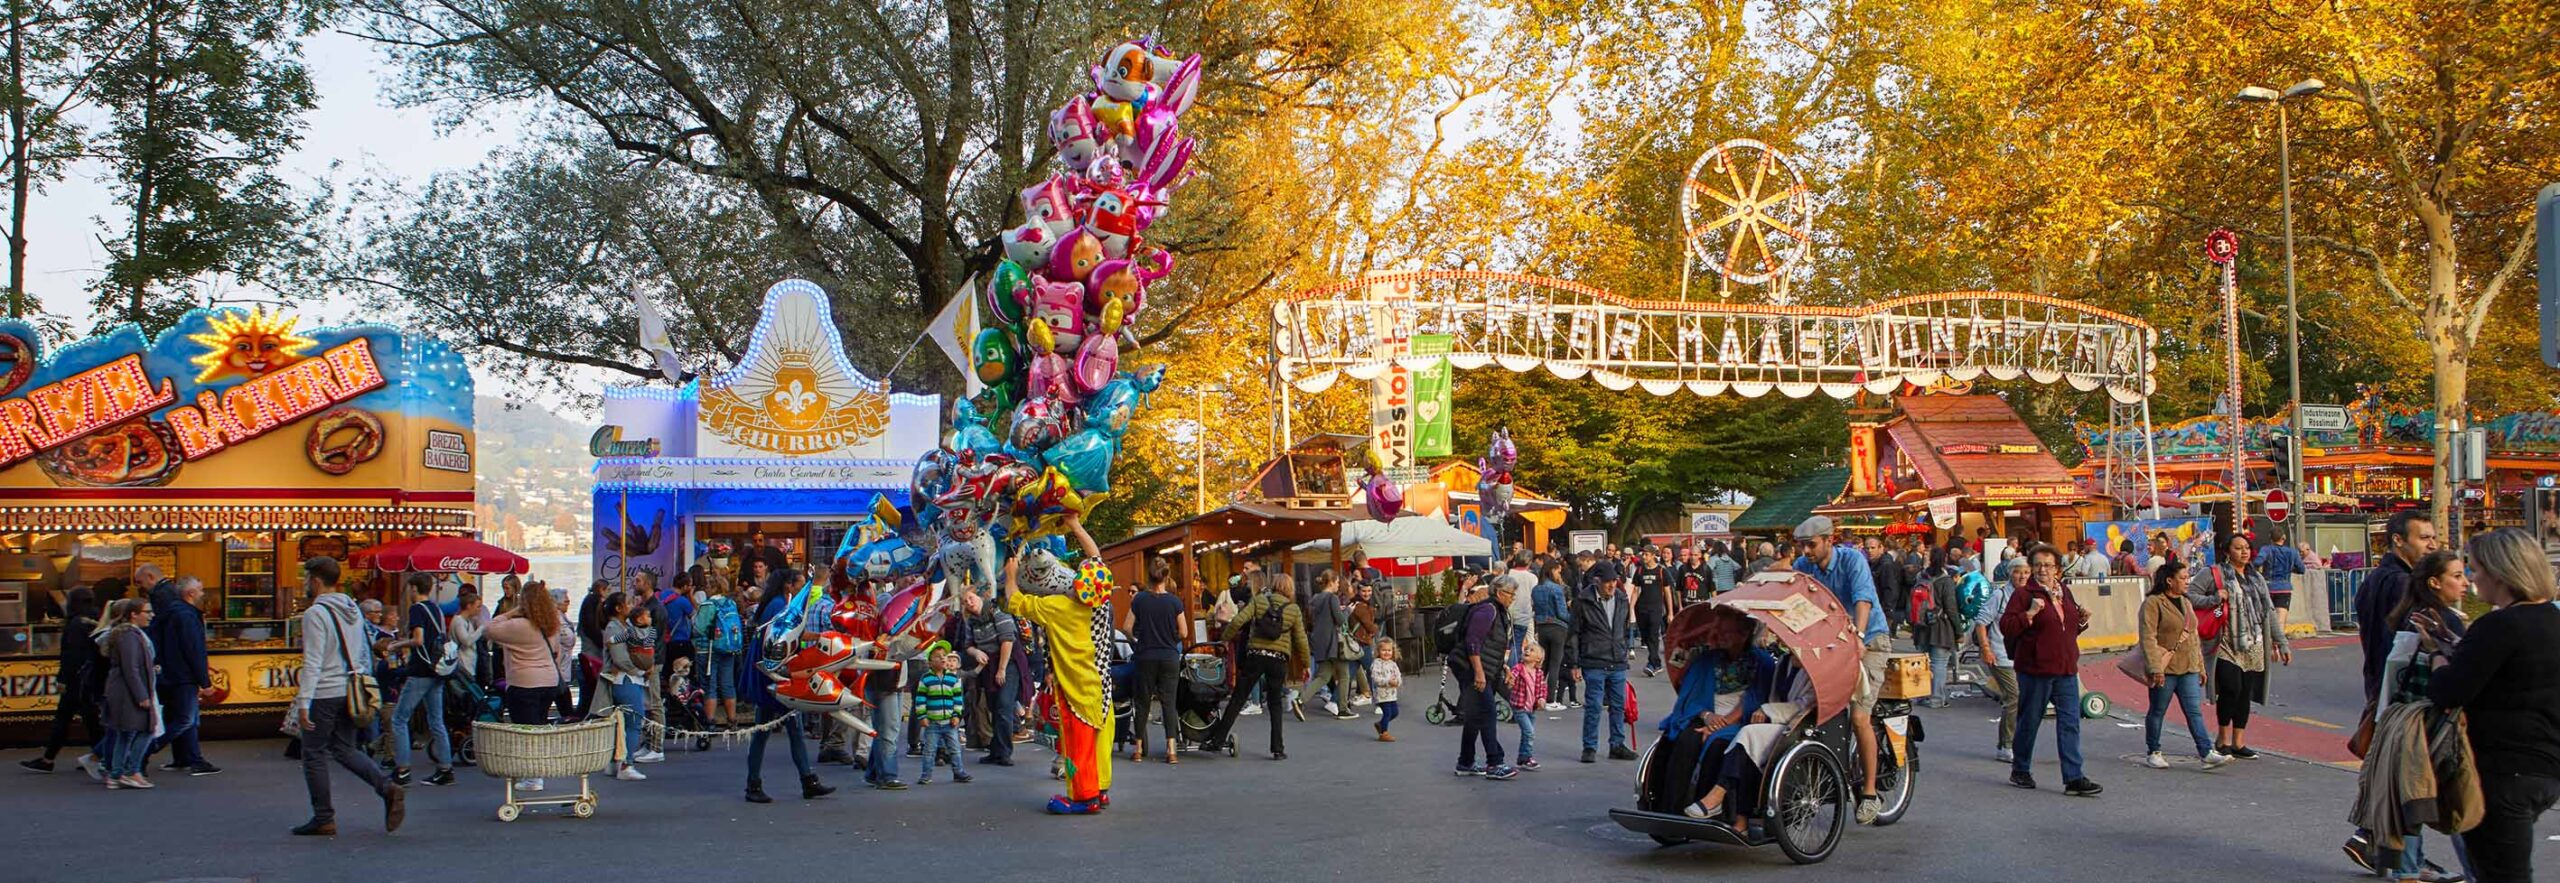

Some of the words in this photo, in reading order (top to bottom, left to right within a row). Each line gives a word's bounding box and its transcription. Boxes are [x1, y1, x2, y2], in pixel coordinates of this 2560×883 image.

[165, 337, 385, 461] BÄCKEREI
[2304, 408, 2341, 418] Industriezone
[432, 433, 463, 450] BREZEL
[733, 425, 858, 451] CHURROS
[653, 465, 674, 479] Tee
[753, 466, 787, 479] Charles
[789, 466, 825, 482] Gourmet
[828, 466, 837, 479] to
[839, 466, 855, 482] Go
[151, 511, 286, 525] OFENFRISCHE
[291, 511, 366, 524] BUTTER
[373, 512, 438, 525] BREZEL
